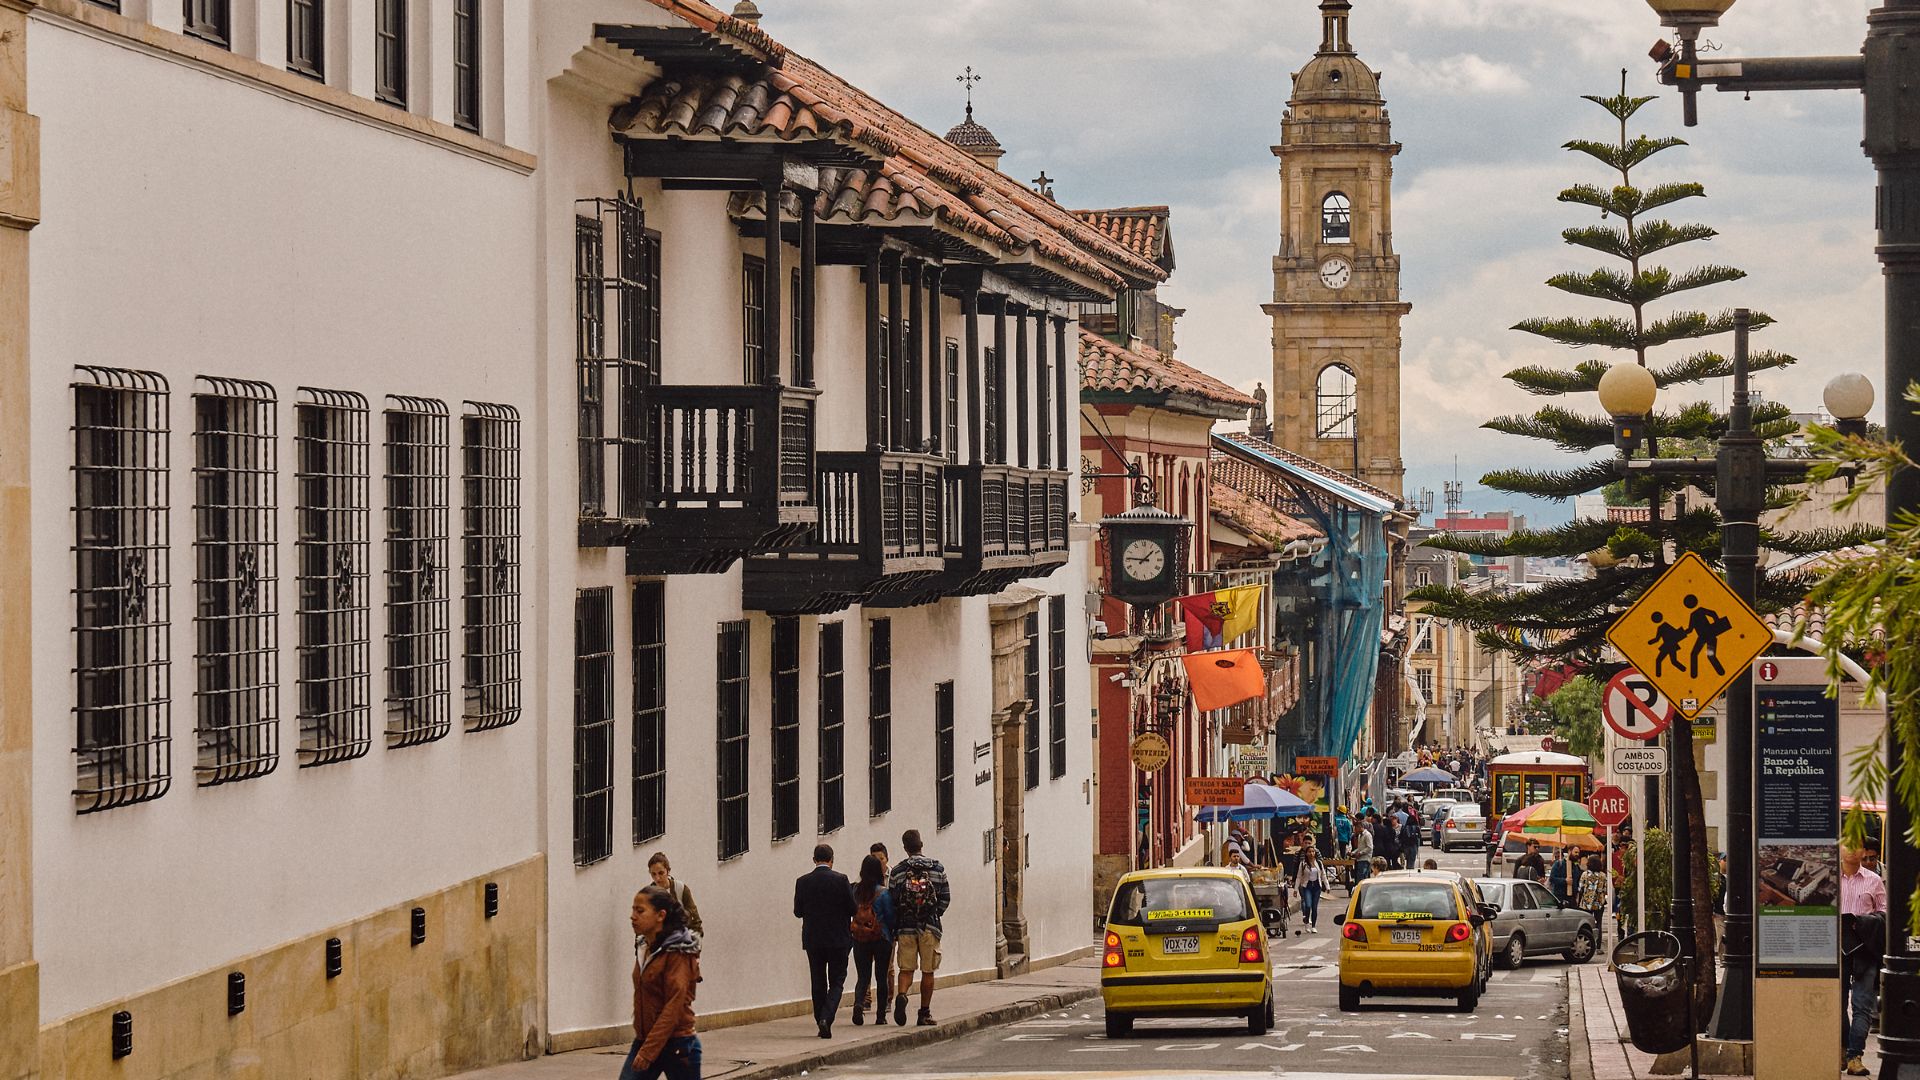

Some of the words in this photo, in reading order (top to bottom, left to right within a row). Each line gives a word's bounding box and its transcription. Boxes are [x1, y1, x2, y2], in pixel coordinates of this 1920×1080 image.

[1625, 681, 1658, 726] P
[1763, 747, 1798, 755] Manzana
[1800, 747, 1832, 755] Cultural
[1625, 752, 1655, 760] AMBOS
[1763, 757, 1795, 765] Banco
[1796, 757, 1809, 765] de
[1617, 762, 1662, 770] COSTADOS
[1763, 766, 1773, 775] la
[1775, 766, 1825, 777] República
[1593, 798, 1626, 814] PARE
[1069, 1043, 1377, 1052] ZONA
